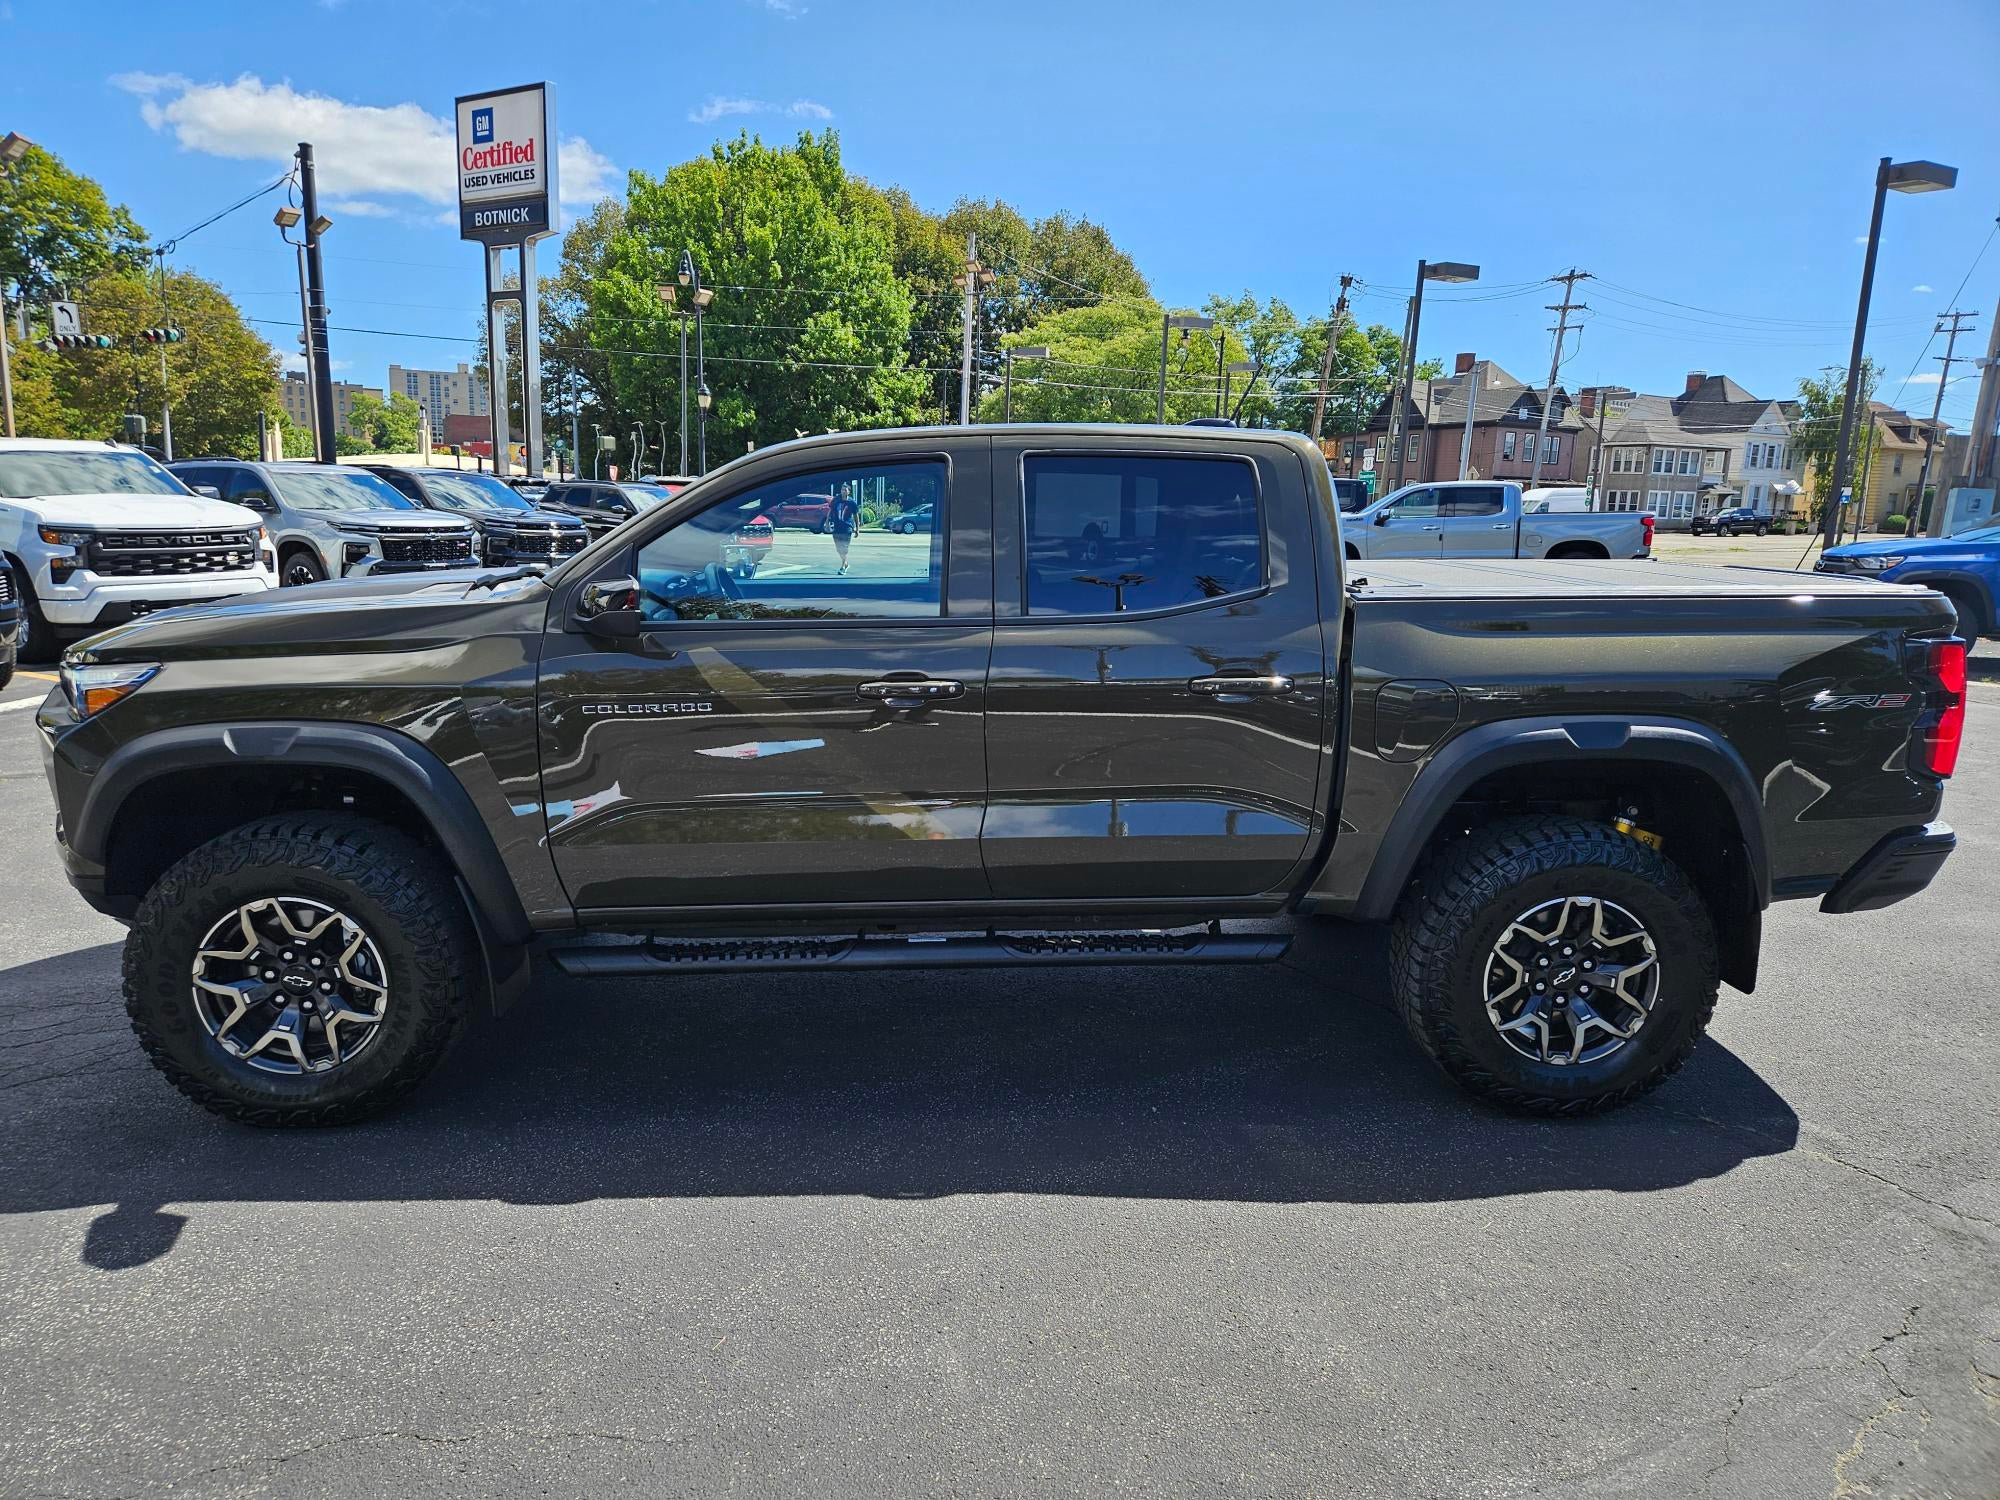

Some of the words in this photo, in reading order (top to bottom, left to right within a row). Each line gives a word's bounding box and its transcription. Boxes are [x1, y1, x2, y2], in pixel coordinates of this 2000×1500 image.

[477, 115, 489, 132] GM
[463, 138, 535, 171] Certified
[464, 175, 488, 188] USED
[490, 169, 535, 184] VEHICLES
[475, 207, 529, 227] BOTNICK
[106, 534, 248, 546] CHEVROLET
[582, 702, 713, 715] COLORADO
[1808, 690, 1912, 711] ZR2
